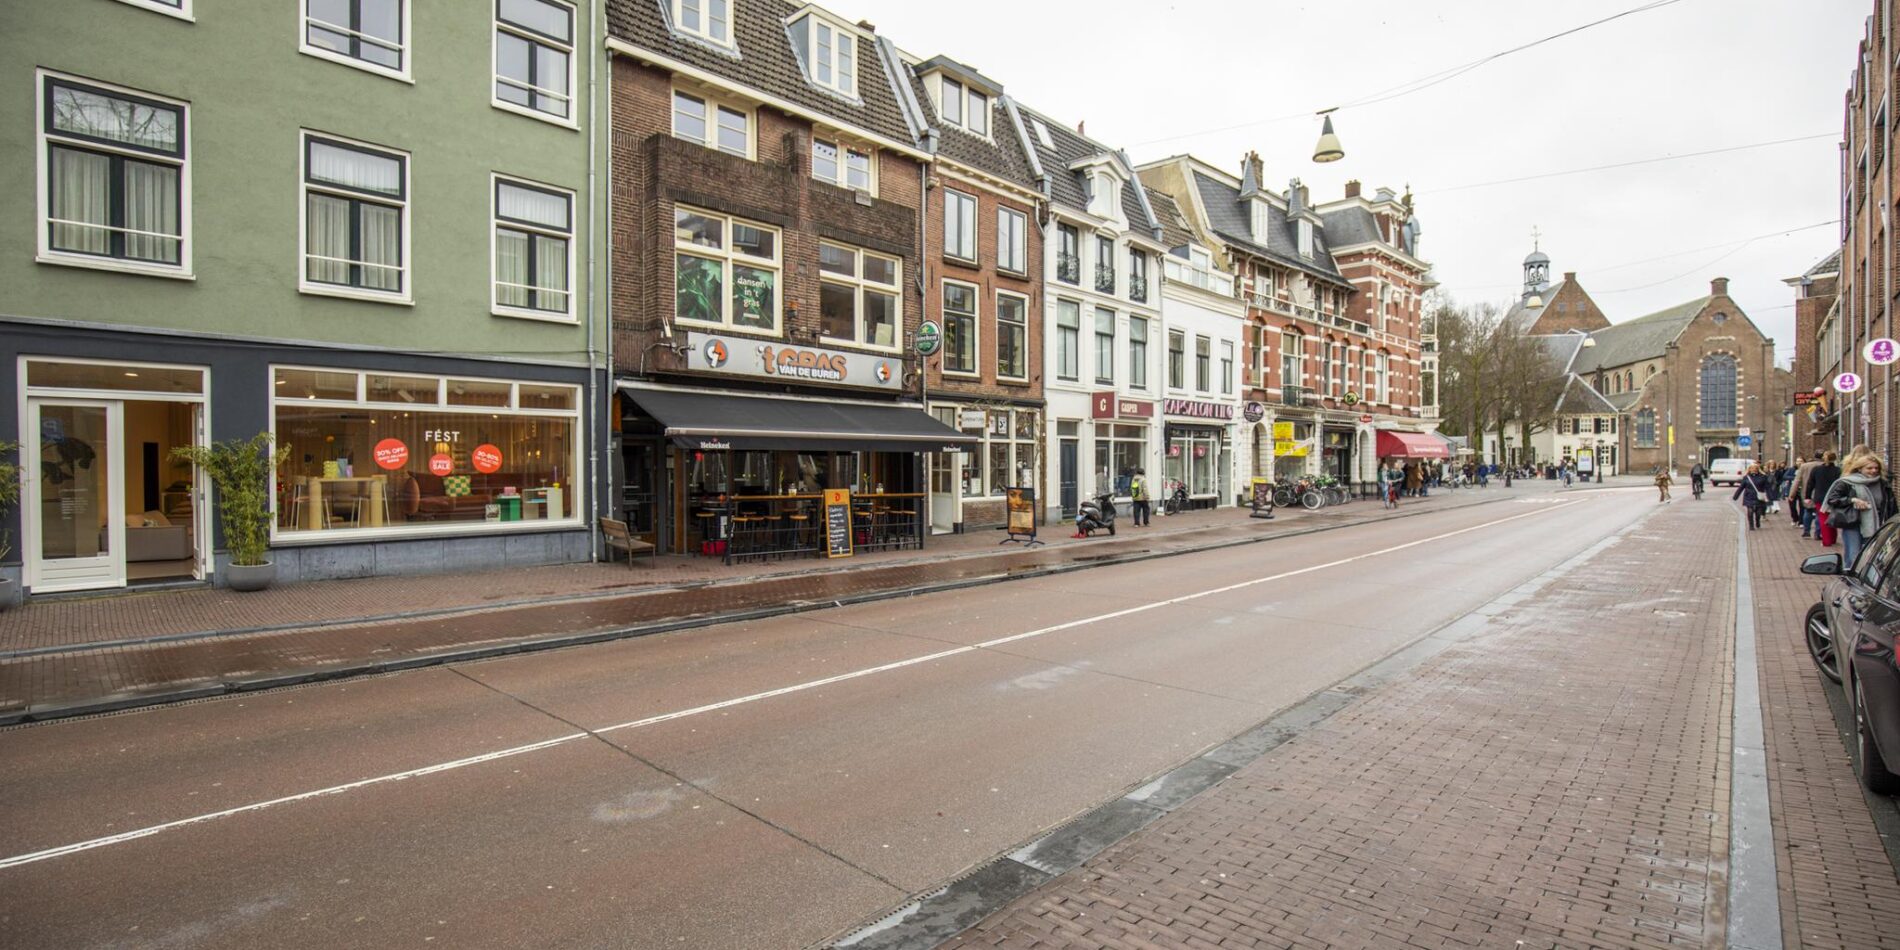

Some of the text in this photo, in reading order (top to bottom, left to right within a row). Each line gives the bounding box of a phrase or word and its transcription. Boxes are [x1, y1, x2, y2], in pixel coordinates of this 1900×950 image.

[737, 275, 766, 289] dansen
[744, 286, 753, 297] in
[779, 365, 840, 380] VAN DE BUREN
[1164, 399, 1213, 418] KAPSALON
[424, 429, 460, 442] FÉST
[700, 441, 731, 449] Heineken
